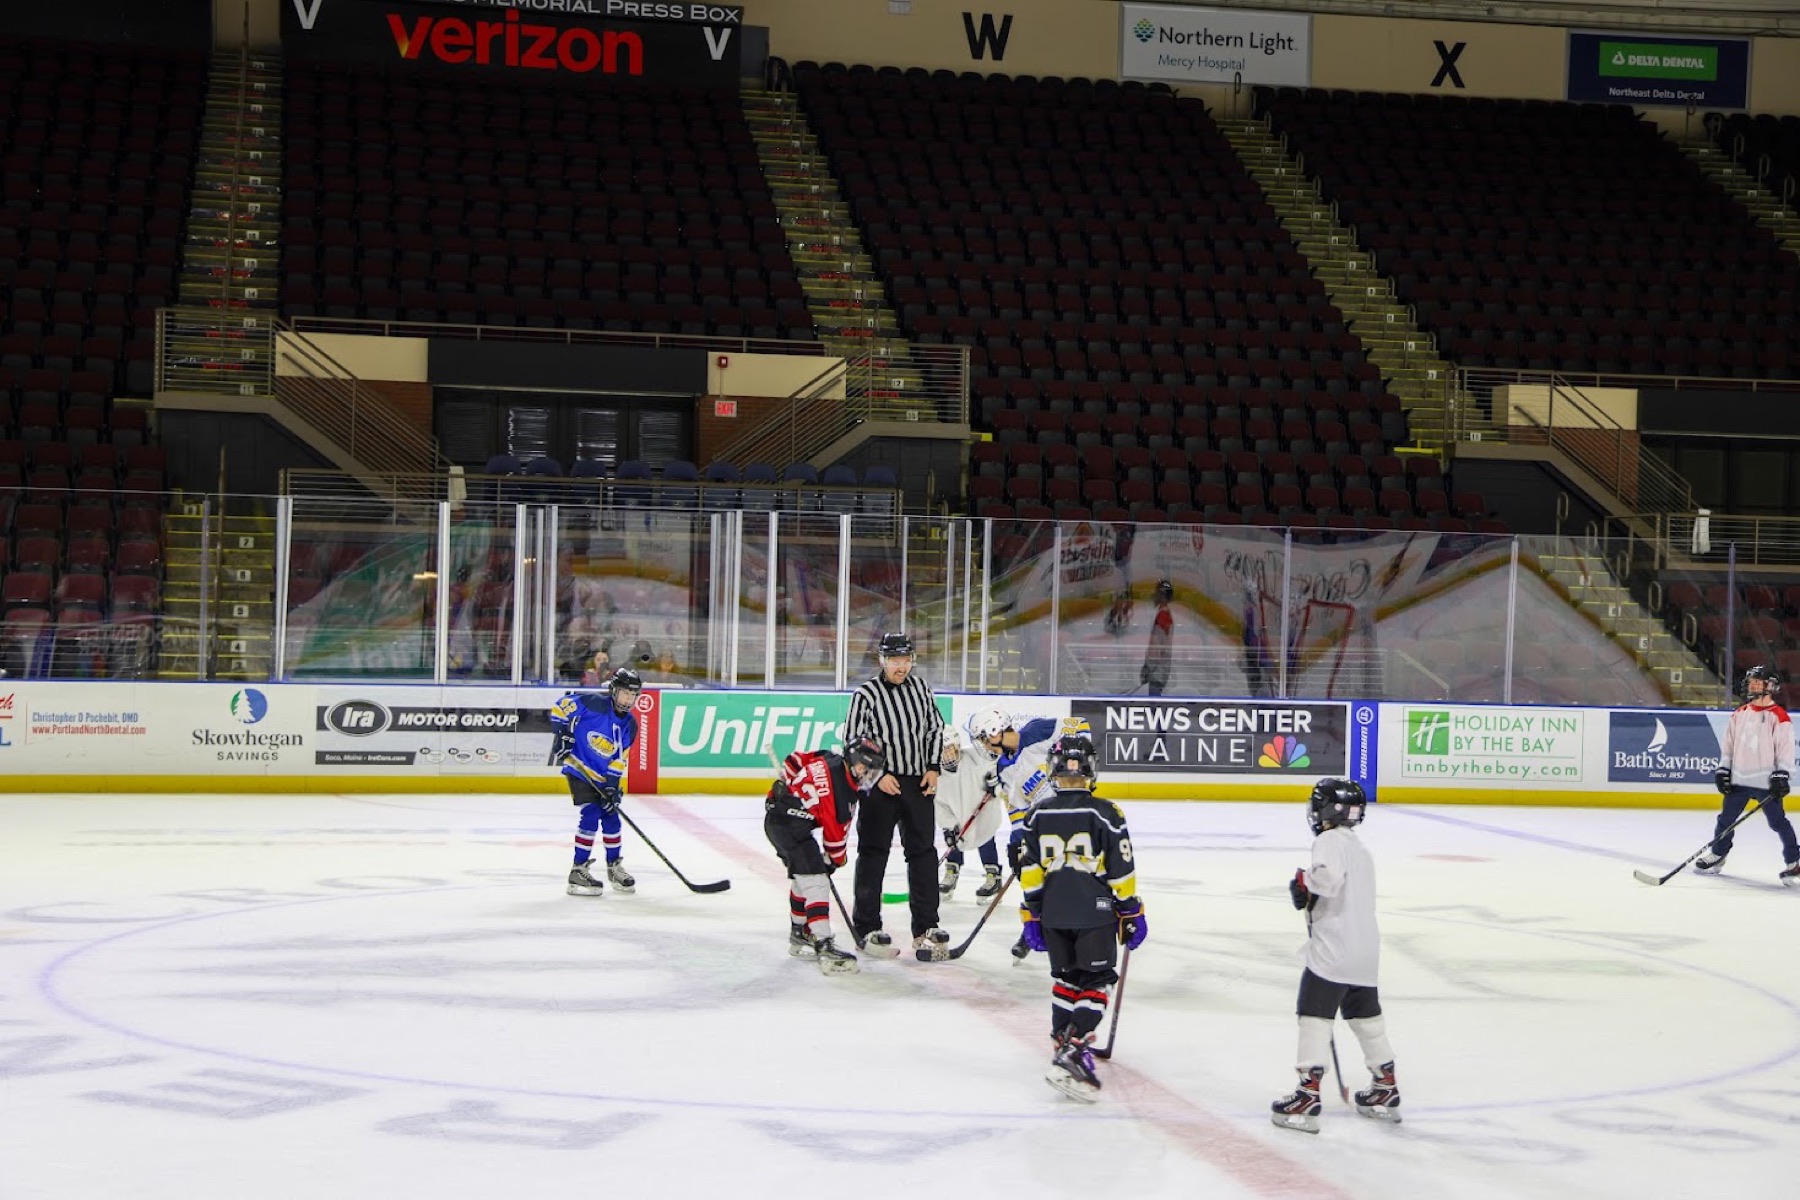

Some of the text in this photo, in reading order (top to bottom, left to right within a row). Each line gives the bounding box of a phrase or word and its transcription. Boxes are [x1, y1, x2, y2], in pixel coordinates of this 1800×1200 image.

[293, 0, 321, 30] V
[606, 0, 684, 18] PRESS
[690, 4, 739, 23] BOX
[386, 10, 644, 76] verizon
[703, 26, 732, 61] V
[962, 12, 1013, 61] W
[1159, 27, 1295, 55] Northern Light
[1158, 54, 1246, 72] Mercy Hospital
[1430, 40, 1467, 88] X
[1627, 54, 1704, 69] DELTA DENTAL
[1608, 86, 1651, 98] Northeast
[1652, 88, 1676, 99] Delta
[716, 402, 735, 415] EXIT
[32, 711, 76, 724] Christopher
[122, 712, 138, 723] DMD
[341, 706, 376, 728] Ira
[398, 712, 520, 728] MOTOR GROUP
[1105, 706, 1312, 733] NEWS CENTER
[1454, 715, 1577, 733] HOLIDAY INN
[32, 724, 146, 735] www.PortlandNorthDental.com
[191, 729, 303, 749] Skowhegan
[667, 705, 846, 755] UniFirs
[639, 714, 648, 771] WARRIOR
[1114, 737, 1246, 763] MAINE
[1359, 726, 1368, 780] WARRIOR
[1454, 736, 1555, 753] BY THE BAY
[217, 751, 280, 761] SAVINGS
[1614, 752, 1720, 772] Bath Savings
[1406, 759, 1578, 777] innbythebay.com
